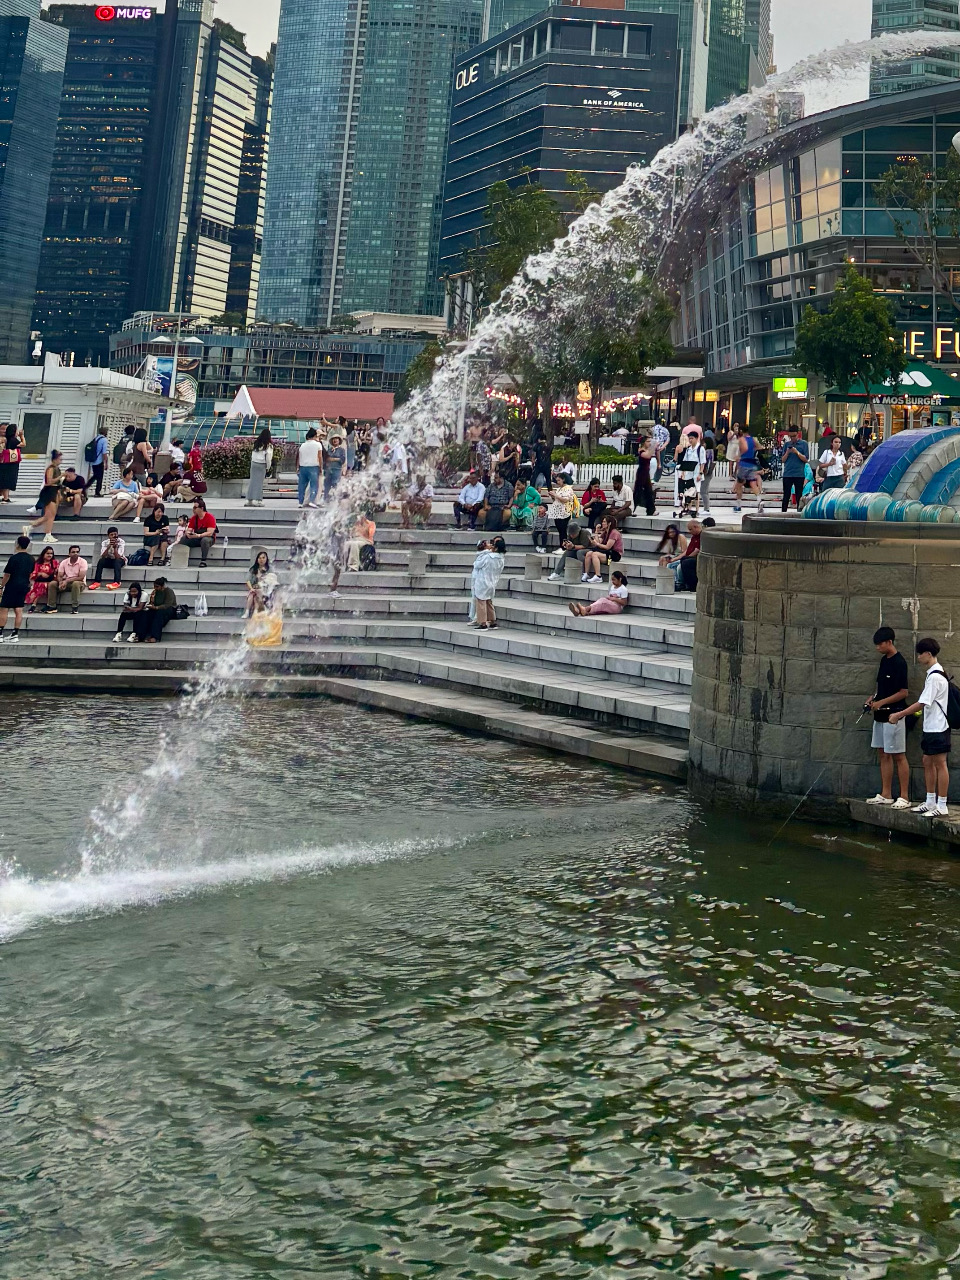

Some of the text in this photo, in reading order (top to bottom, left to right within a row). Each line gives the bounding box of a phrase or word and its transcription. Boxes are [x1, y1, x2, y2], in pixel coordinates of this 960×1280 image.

[116, 8, 151, 19] MUFG
[456, 63, 480, 90] OUE
[882, 396, 942, 406] MOS BURGER
